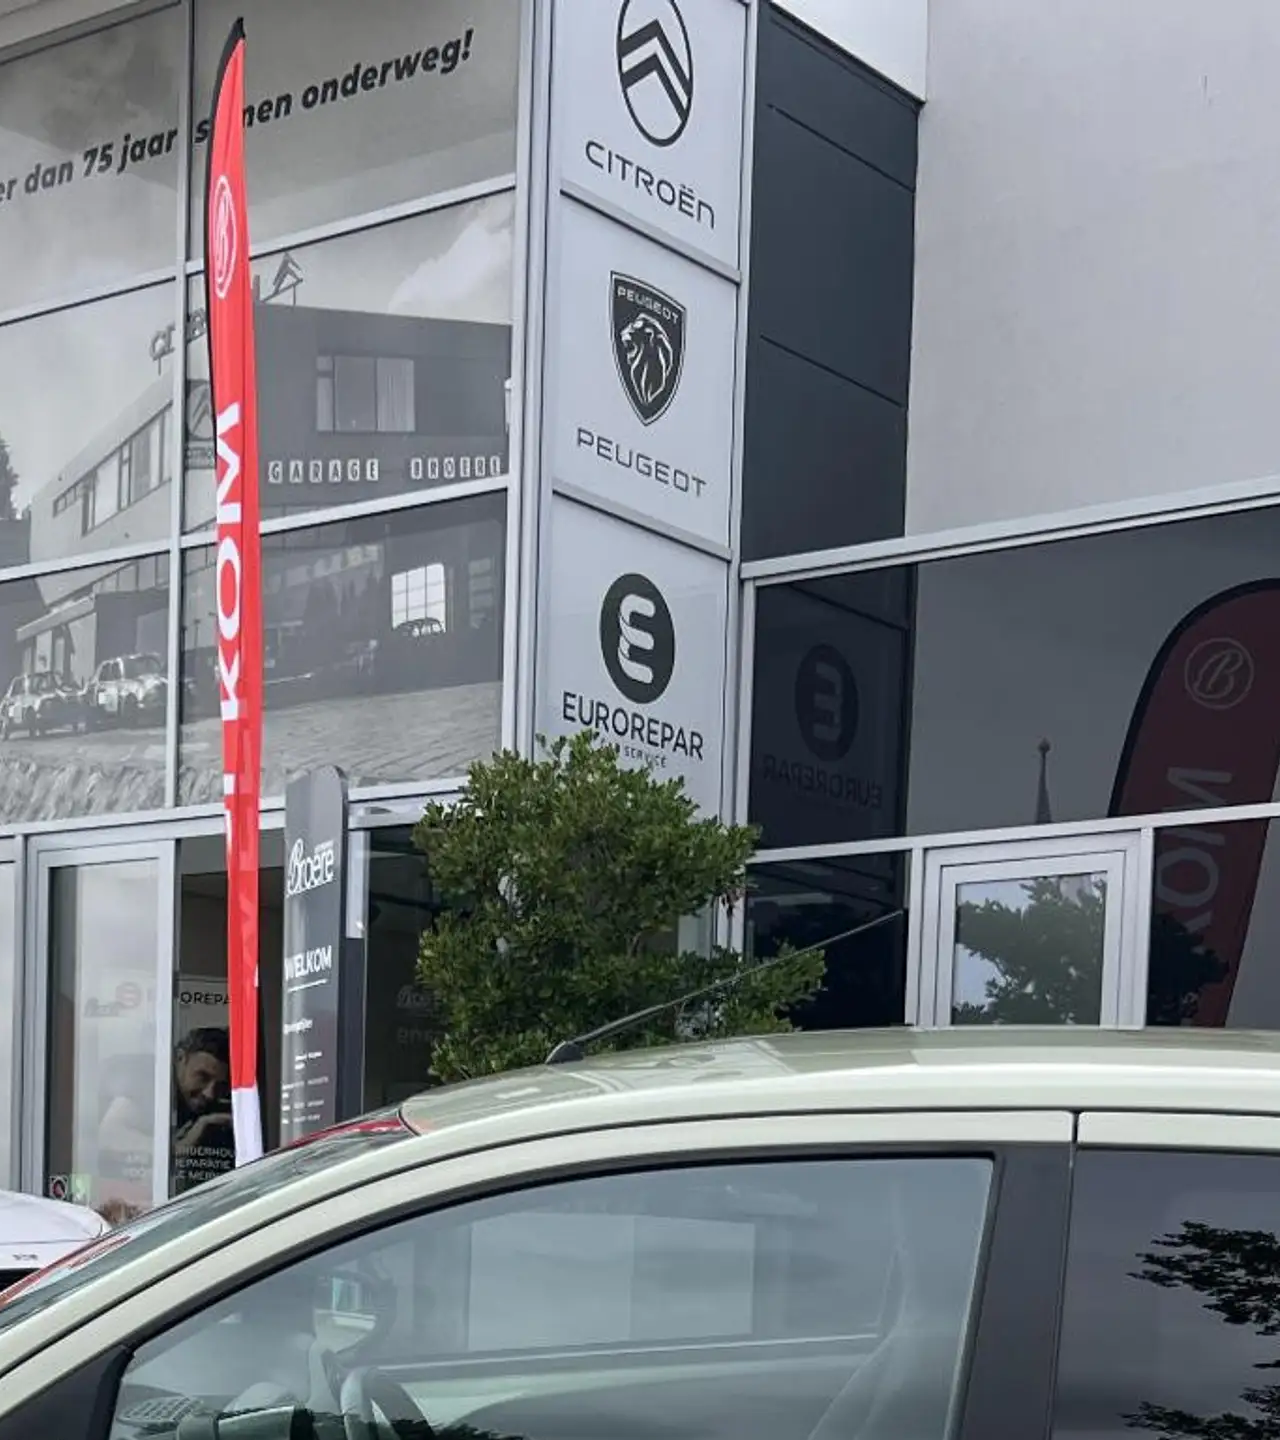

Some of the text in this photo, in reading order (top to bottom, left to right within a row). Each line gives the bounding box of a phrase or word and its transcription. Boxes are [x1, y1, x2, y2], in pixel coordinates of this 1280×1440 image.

[24, 161, 74, 194] dan
[83, 142, 114, 177] 75
[117, 128, 178, 175] jaar
[302, 28, 474, 109] onderweg!
[584, 140, 715, 229] CITROËN
[617, 286, 679, 324] PEUGEOT
[268, 458, 379, 484] GARAGE
[577, 427, 707, 497] PEUGEOT
[562, 691, 704, 760] EUROREPAR
